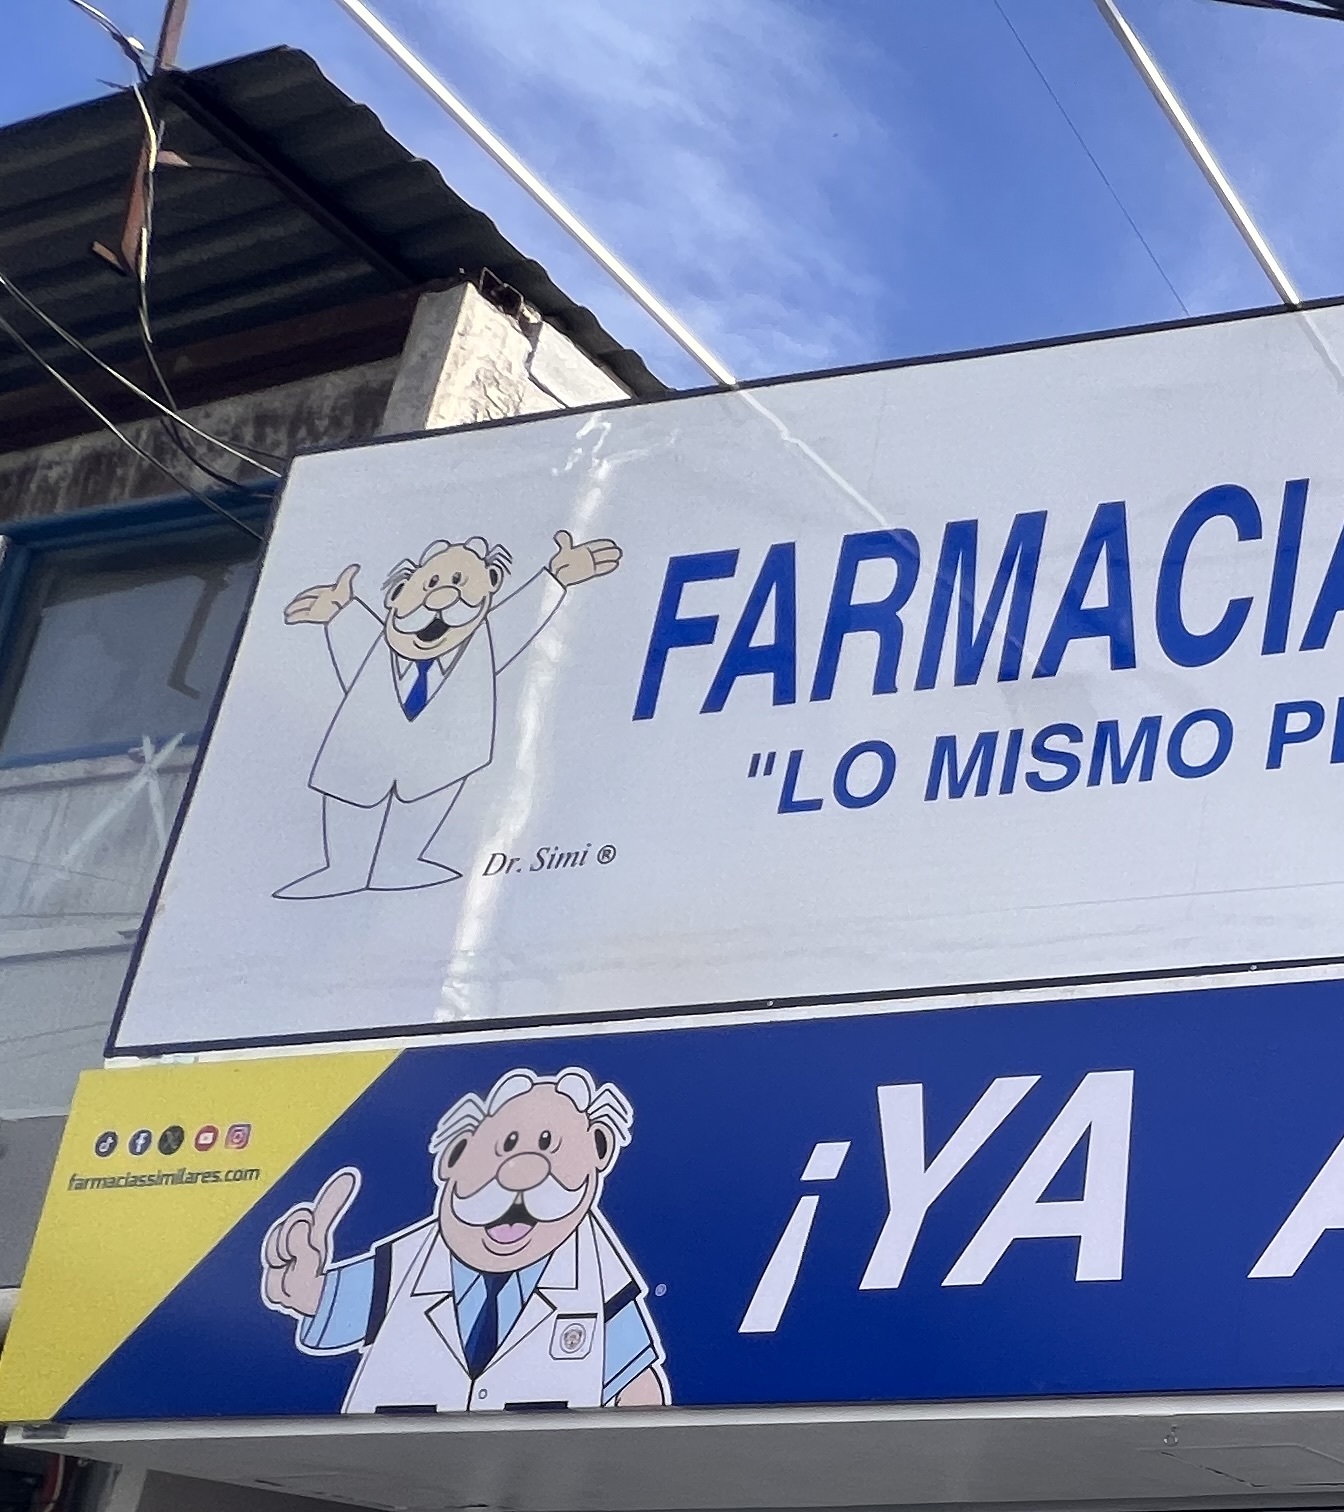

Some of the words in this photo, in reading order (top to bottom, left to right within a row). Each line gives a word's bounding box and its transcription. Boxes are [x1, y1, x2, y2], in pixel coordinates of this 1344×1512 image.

[747, 740, 896, 814] "LO
[925, 709, 1234, 801] MISMO
[482, 852, 521, 876] Dr.
[529, 842, 592, 872] Simi
[67, 1167, 260, 1192] farmaciassimilares.com
[737, 1069, 1137, 1334] ¡YA
